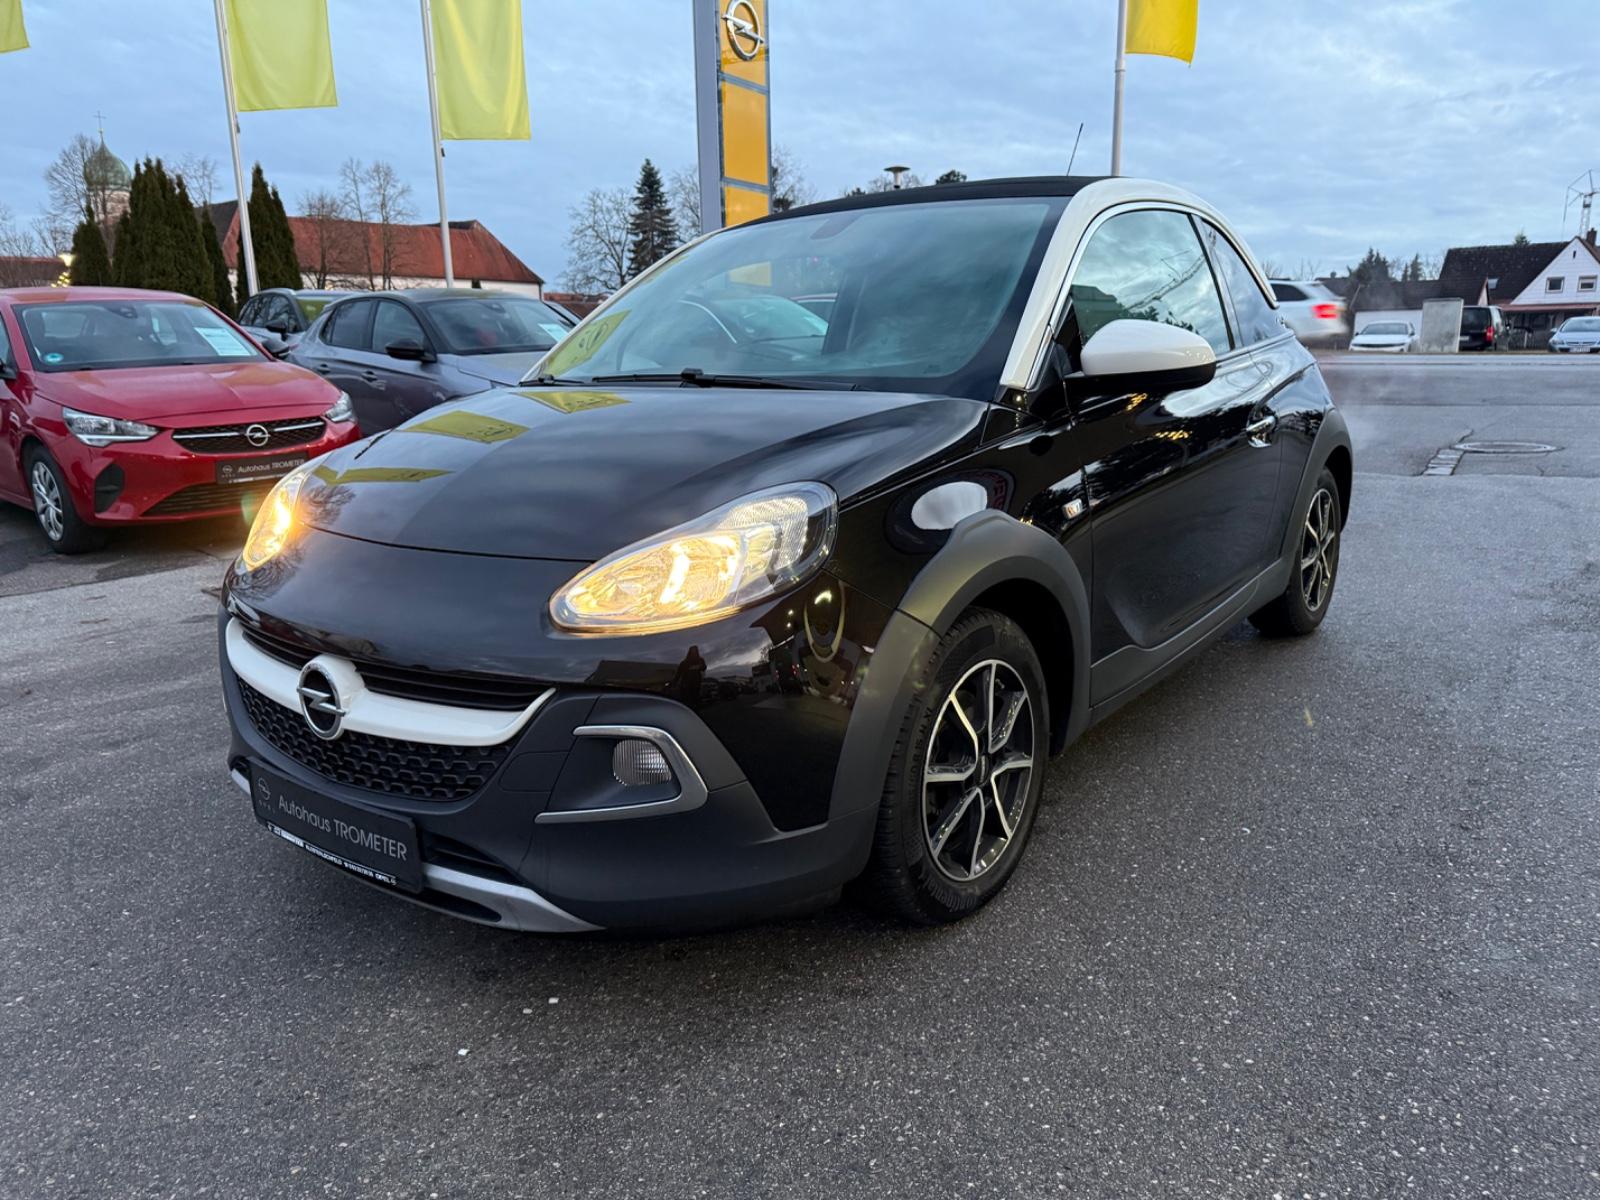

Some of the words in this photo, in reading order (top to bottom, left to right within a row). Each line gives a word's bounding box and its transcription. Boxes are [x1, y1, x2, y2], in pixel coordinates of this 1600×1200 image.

[238, 464, 270, 473] Autohaus
[278, 794, 331, 832] Autohaus
[333, 819, 407, 861] TROMETER
